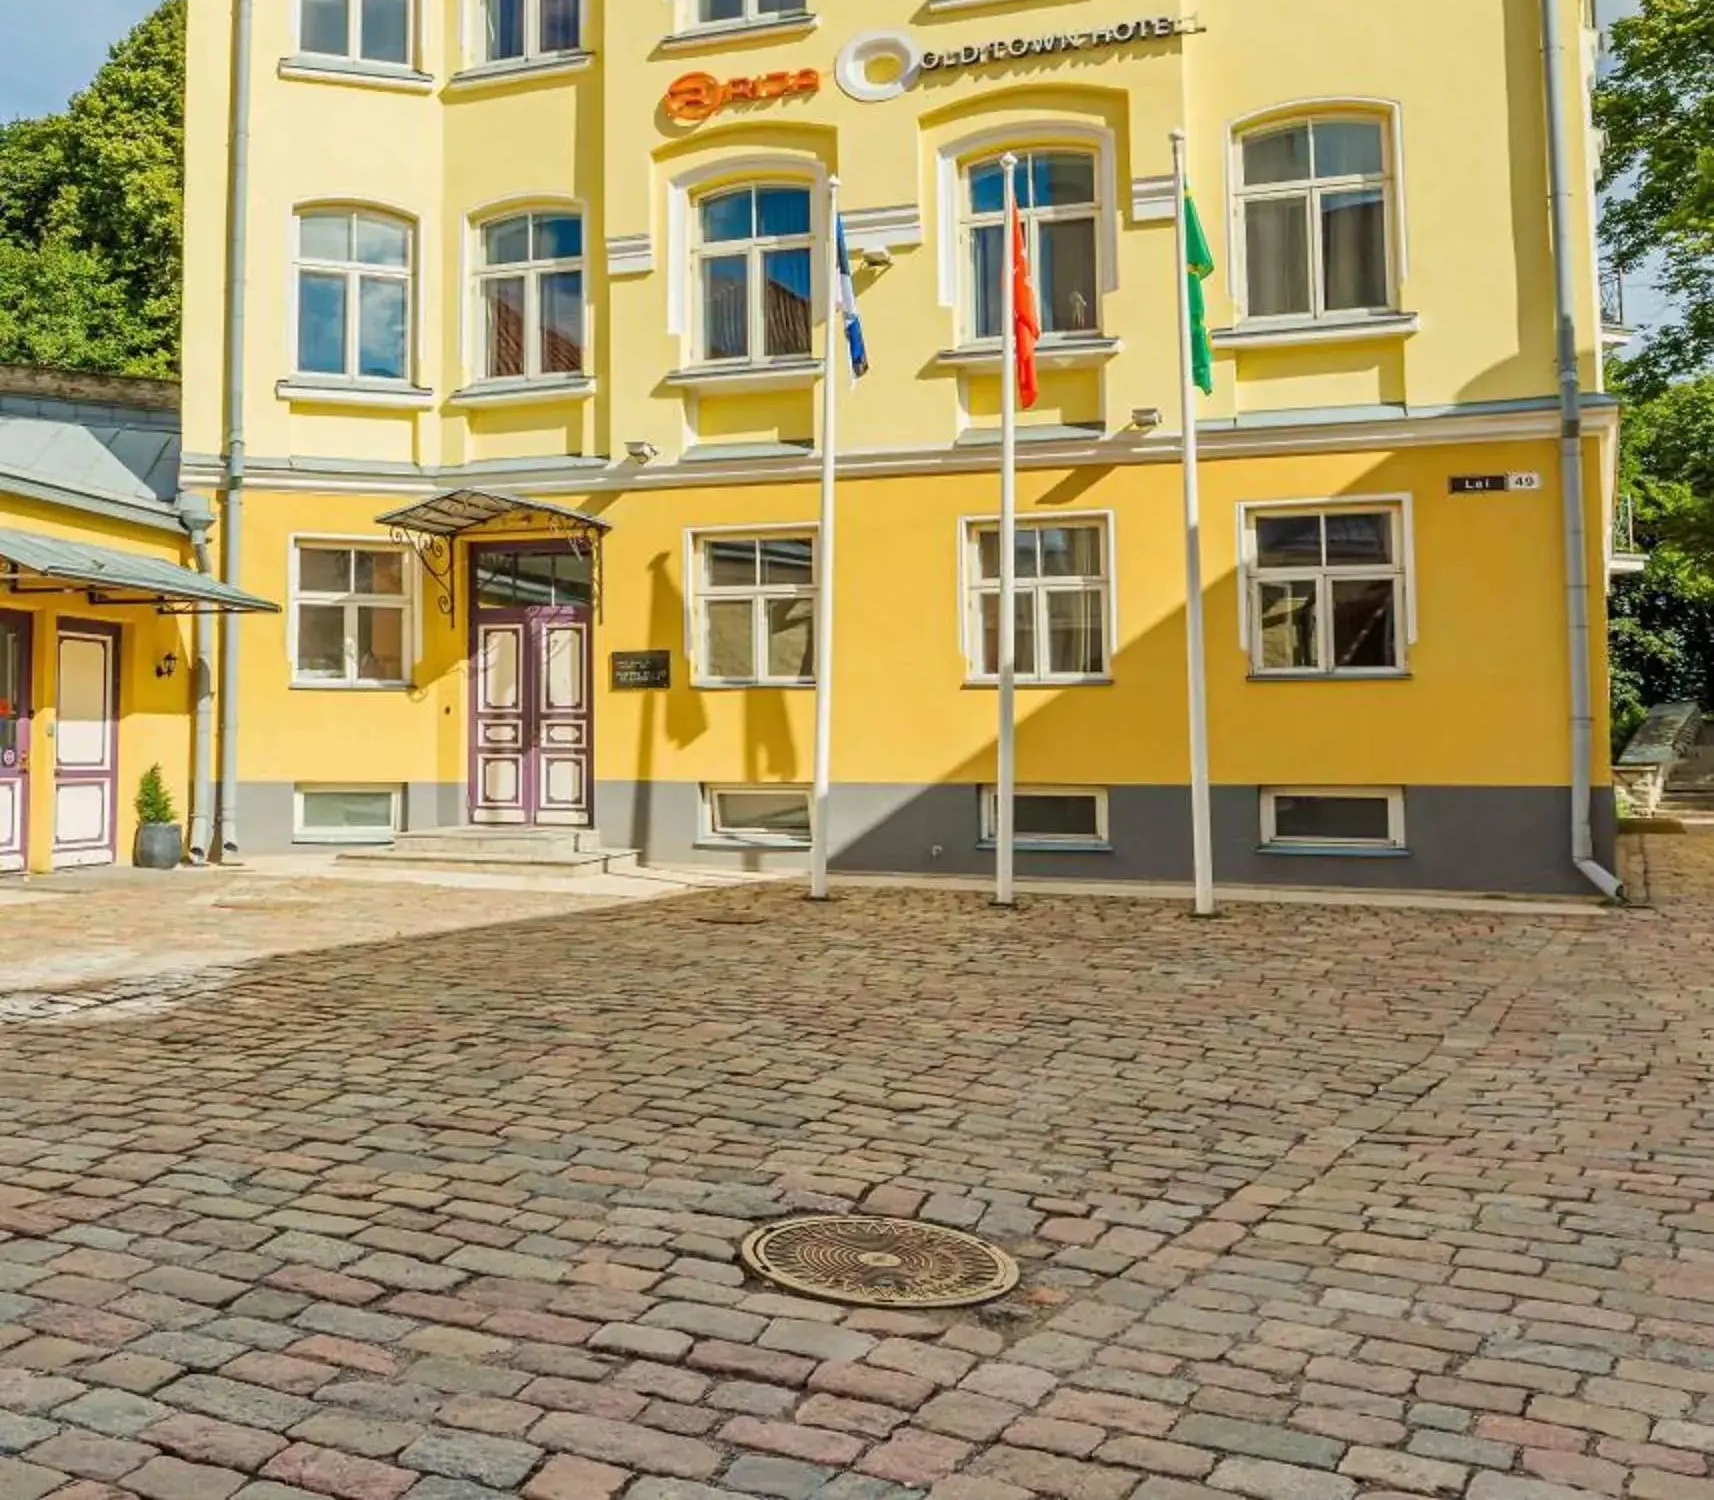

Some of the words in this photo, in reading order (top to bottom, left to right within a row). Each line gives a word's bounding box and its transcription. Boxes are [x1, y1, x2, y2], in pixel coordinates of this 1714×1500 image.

[921, 46, 981, 69] OLD
[986, 33, 1083, 59] TOWN
[1464, 478, 1489, 489] Lai
[1515, 476, 1535, 487] 49
